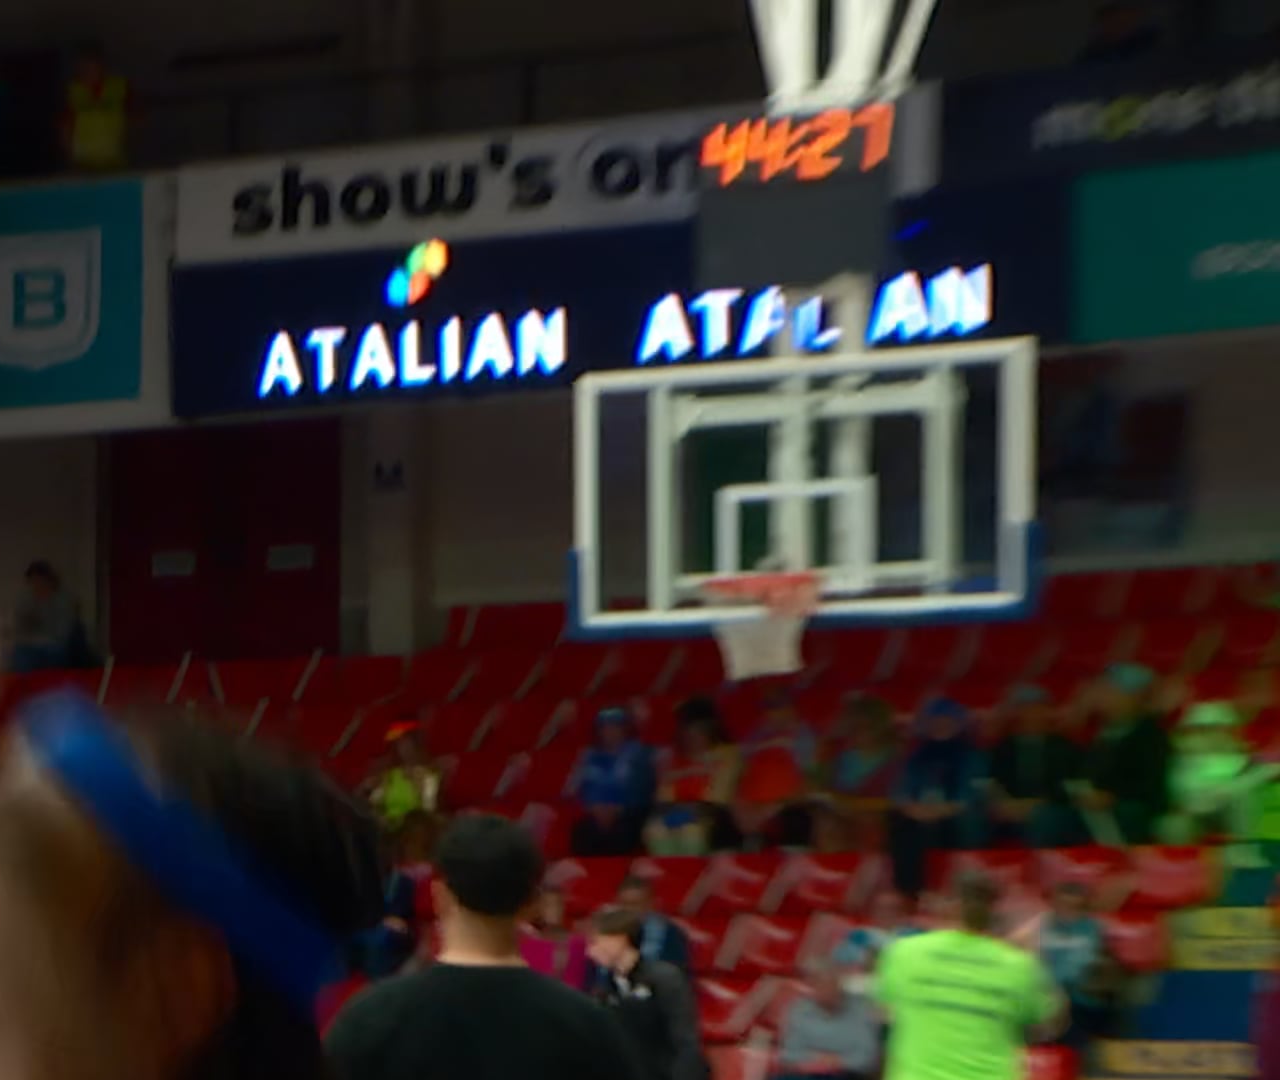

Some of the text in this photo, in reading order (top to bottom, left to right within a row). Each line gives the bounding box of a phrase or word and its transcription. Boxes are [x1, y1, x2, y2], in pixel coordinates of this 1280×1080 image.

[233, 143, 553, 236] show's
[257, 306, 568, 398] ATALIAN
[635, 262, 993, 366] ATALAN
